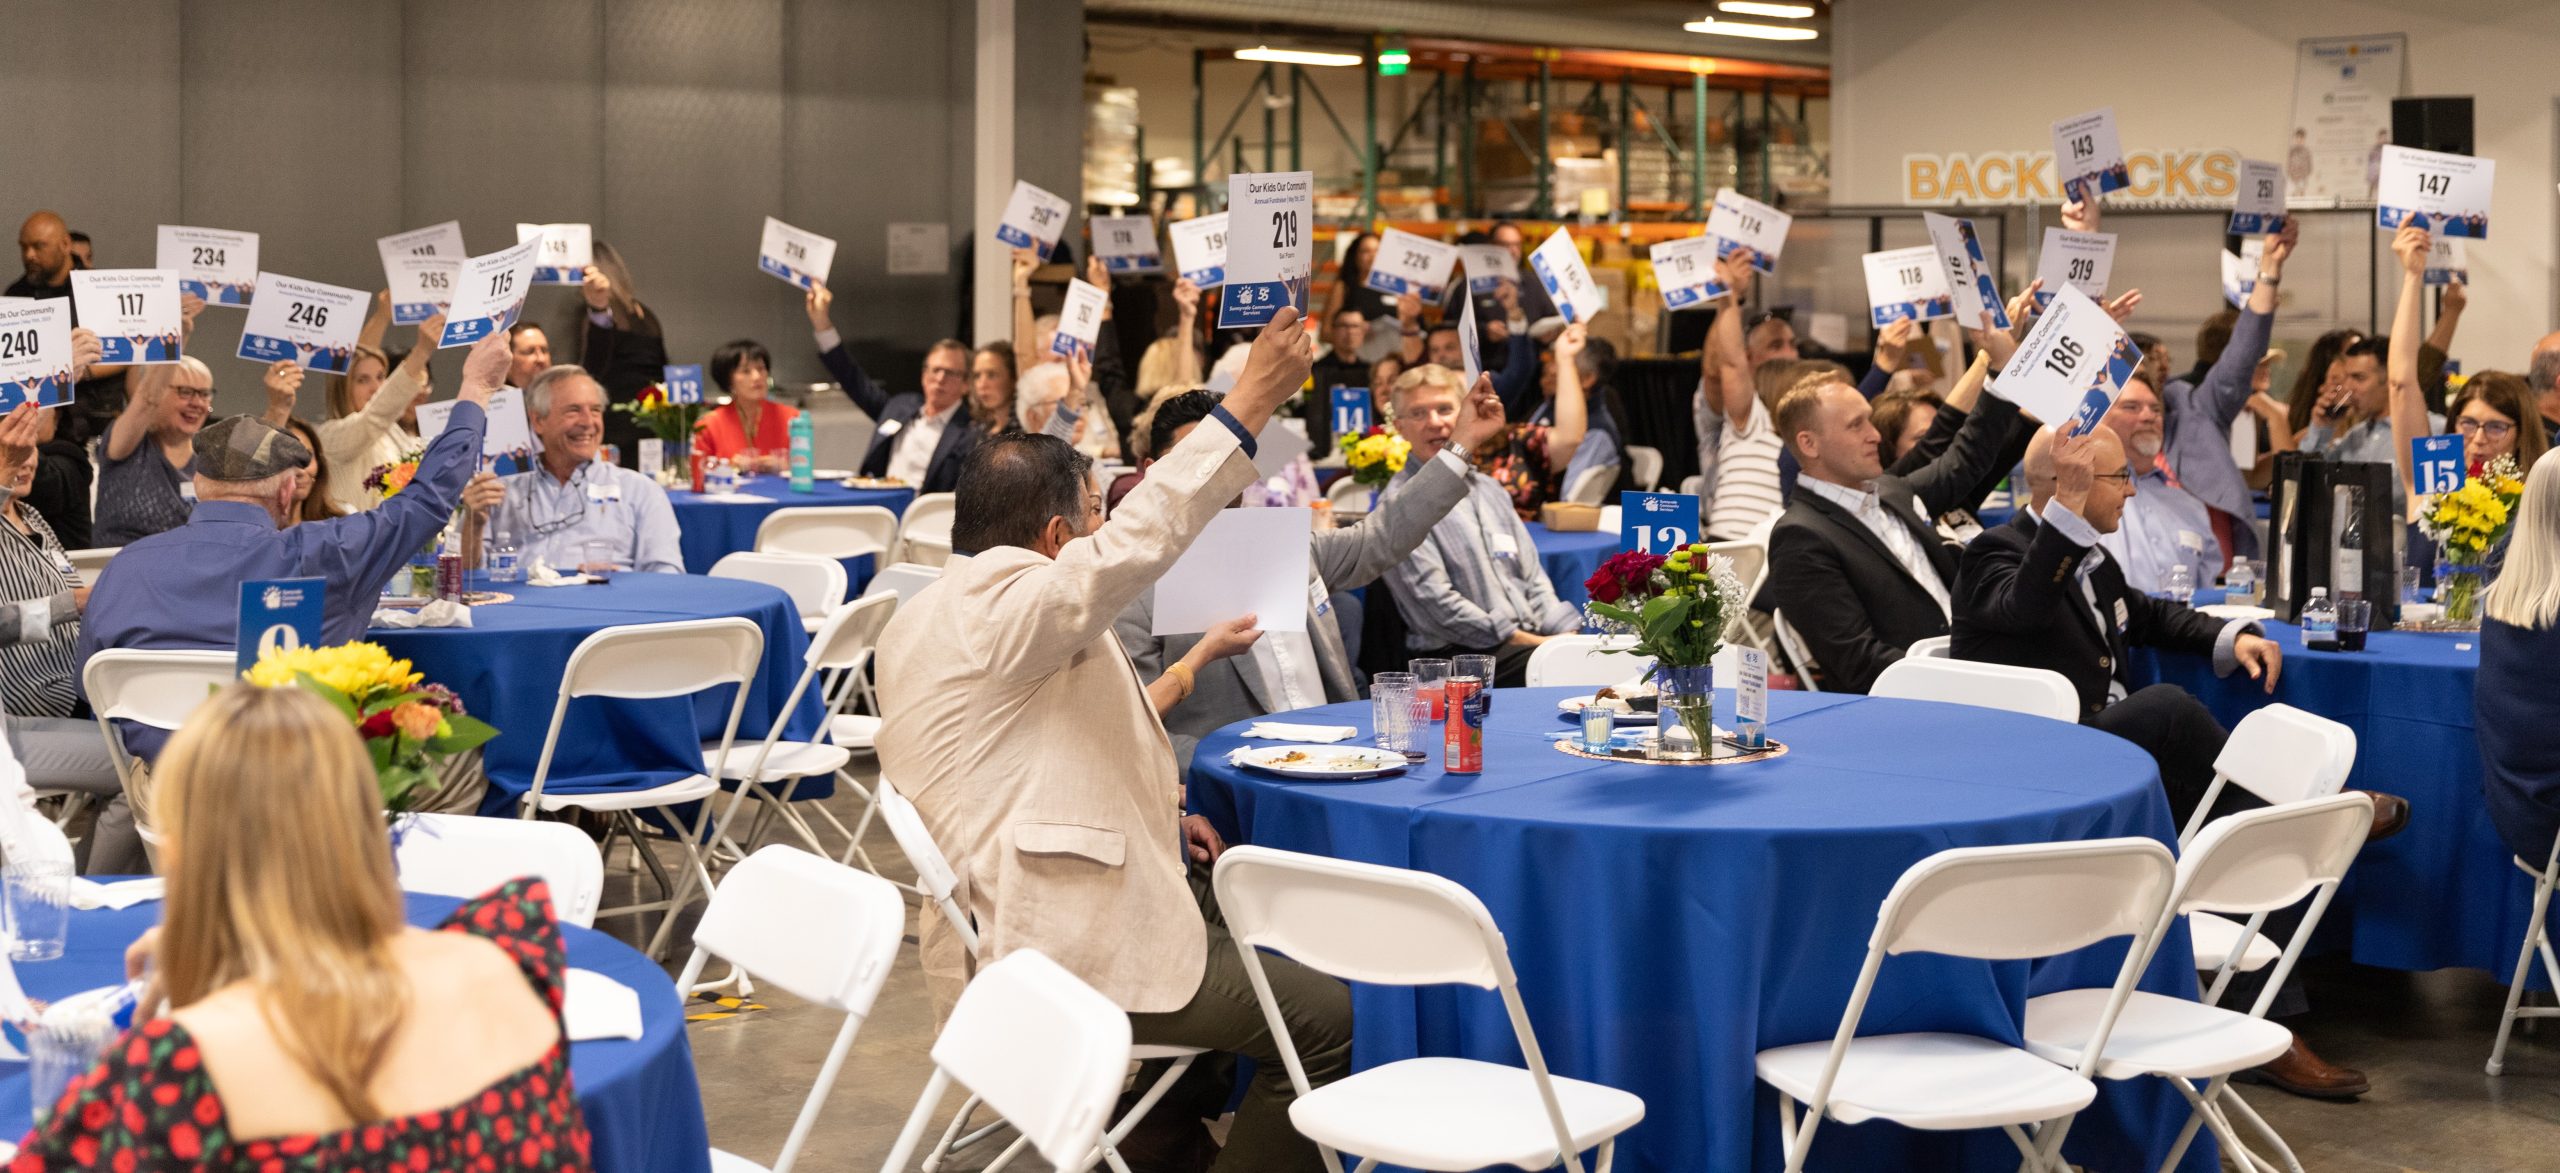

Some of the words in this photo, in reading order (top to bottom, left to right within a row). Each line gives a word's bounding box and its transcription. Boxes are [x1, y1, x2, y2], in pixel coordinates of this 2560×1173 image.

[2072, 134, 2093, 159] 143
[1250, 184, 1262, 193] Our
[1263, 182, 1276, 192] Kids
[1277, 182, 1286, 191] Our
[1909, 154, 2237, 199] BACKCKS
[2419, 173, 2451, 195] 147
[1272, 210, 1297, 248] 219
[192, 247, 225, 267] 234
[2069, 258, 2094, 280] 319
[420, 272, 449, 288] 265
[490, 269, 514, 296] 115
[1900, 266, 1923, 285] 118
[1949, 256, 1967, 286] 116
[8, 310, 19, 318] Our
[20, 306, 55, 317] Community
[117, 294, 144, 315] 117
[288, 302, 328, 327] 246
[1, 329, 39, 359] 240
[2010, 365, 2022, 377] Our
[2020, 350, 2032, 366] Kids
[2030, 338, 2041, 350] Our
[2038, 302, 2068, 338] Community
[2045, 335, 2085, 378] 186
[672, 380, 699, 403] 13
[1338, 406, 1368, 433] 14
[2419, 458, 2459, 494] 15
[1632, 525, 1687, 556] 12
